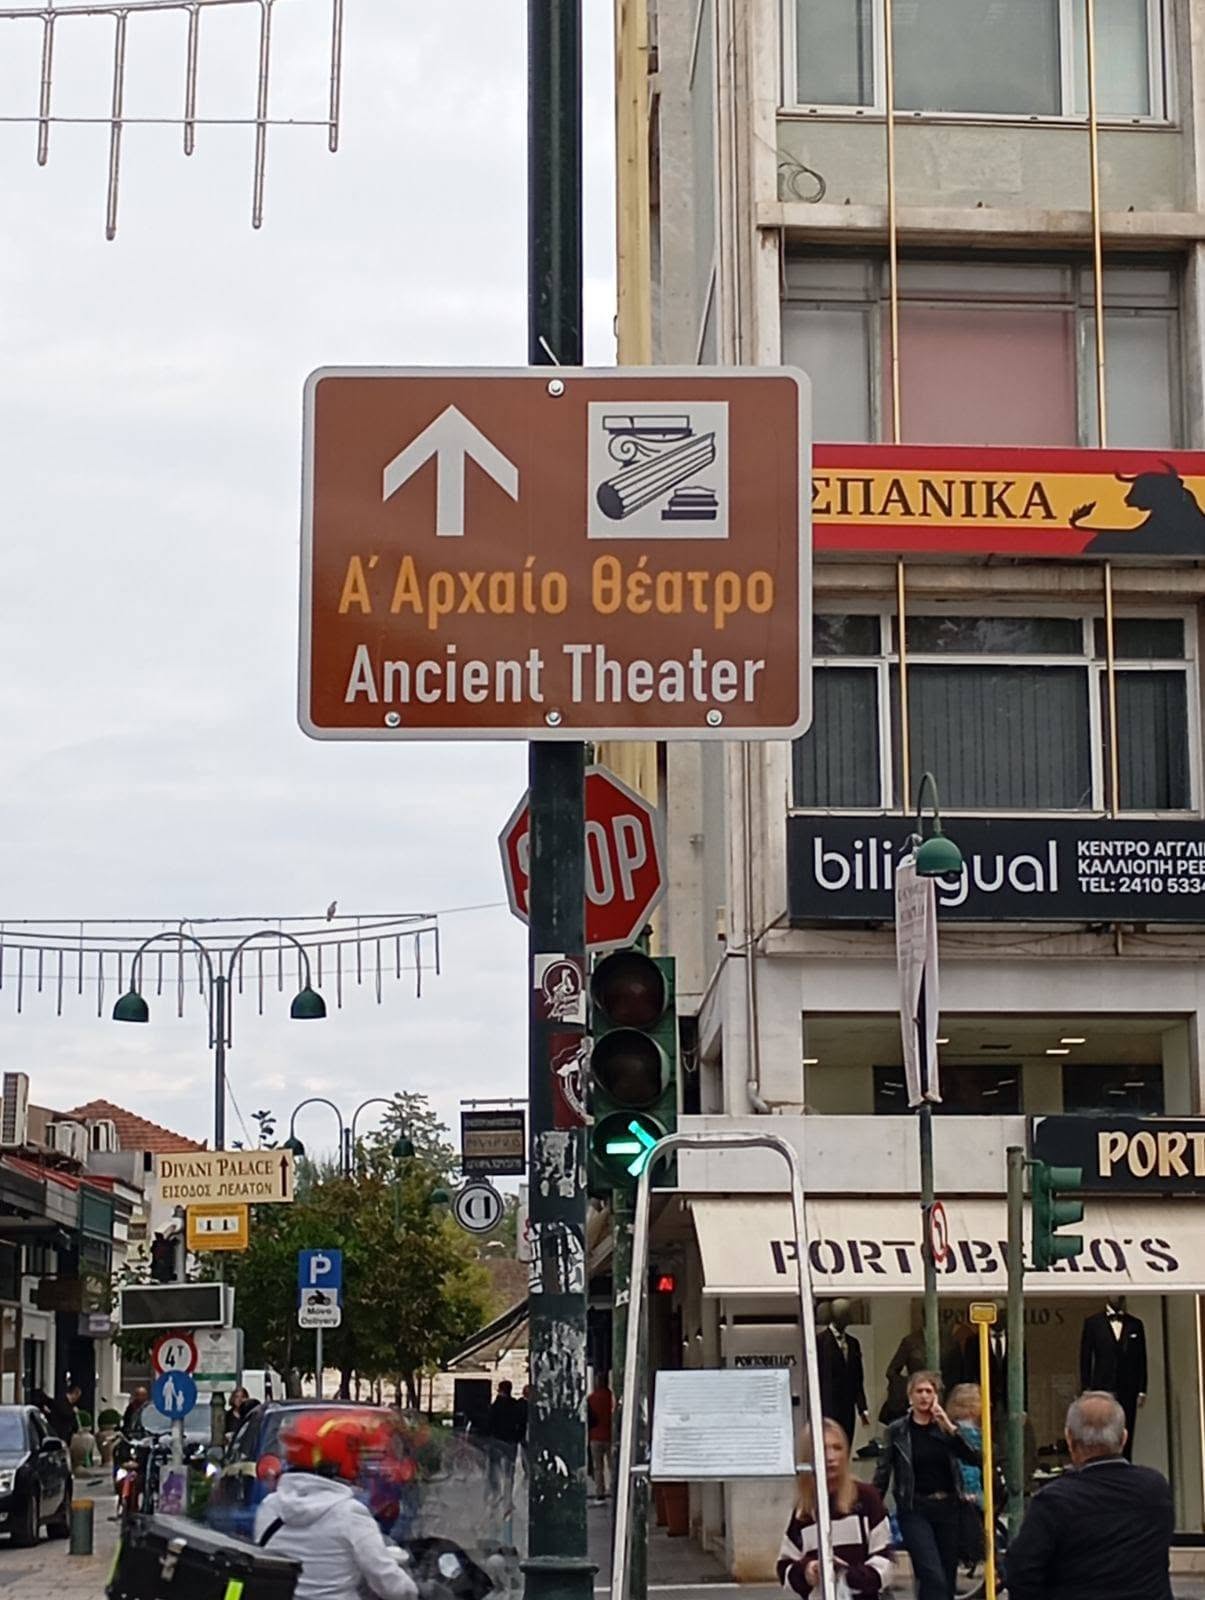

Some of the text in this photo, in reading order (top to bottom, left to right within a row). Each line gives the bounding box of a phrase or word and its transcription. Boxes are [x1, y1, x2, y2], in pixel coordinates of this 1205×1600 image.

[391, 555, 568, 629] Αρχαίο
[592, 554, 775, 629] Θέατρο
[345, 644, 765, 703] Ancient Theater
[1077, 841, 1205, 857] ΚΕΝΤΡΟ ΑΓΓΛΙ
[814, 837, 1058, 907] biligual
[1078, 859, 1173, 874] ΚΑΛΛΙΟΠΗ
[1078, 877, 1116, 893] TEL:
[1119, 877, 1163, 893] 2410
[161, 1158, 274, 1178] DIVANI PALACE
[162, 1184, 211, 1199] ΕΙΣΟΔΟΣ
[310, 1255, 332, 1284] P
